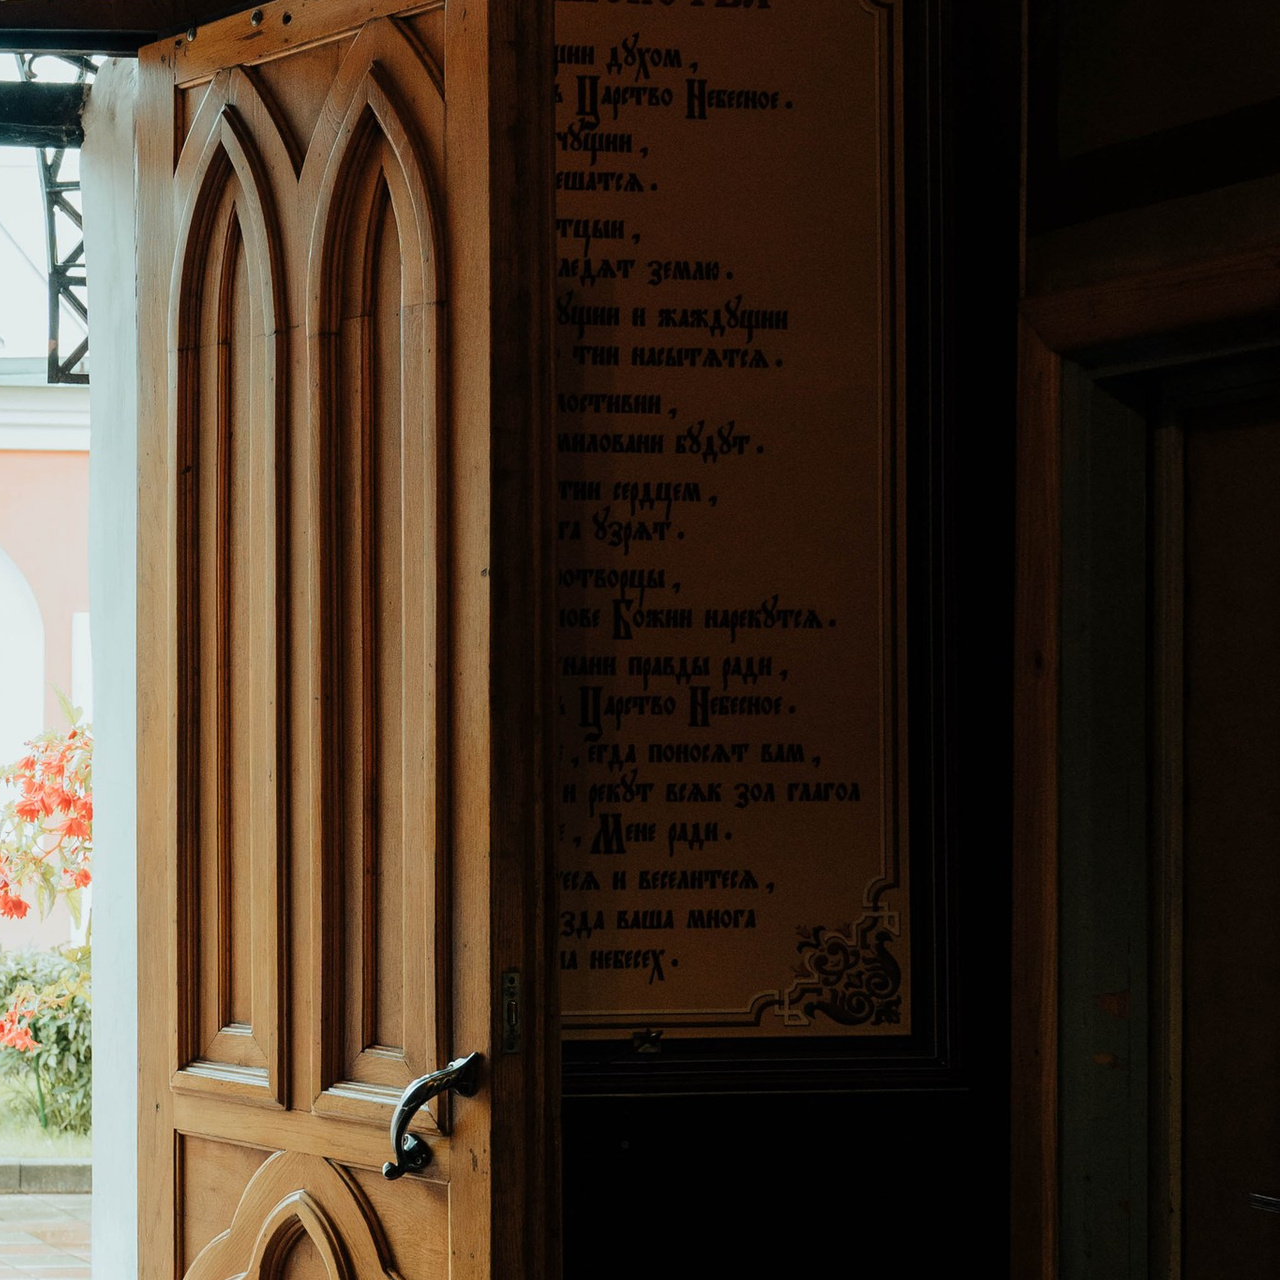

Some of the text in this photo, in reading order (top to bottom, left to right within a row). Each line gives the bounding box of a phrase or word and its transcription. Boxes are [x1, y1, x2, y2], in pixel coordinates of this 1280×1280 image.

[576, 74, 674, 131] Царство
[631, 307, 646, 327] и
[612, 598, 693, 640] Божии
[559, 655, 616, 676] нани
[628, 656, 710, 691] правды
[578, 683, 676, 749] Царство
[588, 744, 638, 773] егда
[734, 782, 776, 809] зол
[786, 782, 861, 802] глагол
[590, 811, 656, 855] Мене
[612, 871, 627, 891] и
[616, 909, 675, 930] ваша
[686, 909, 757, 929] многа
